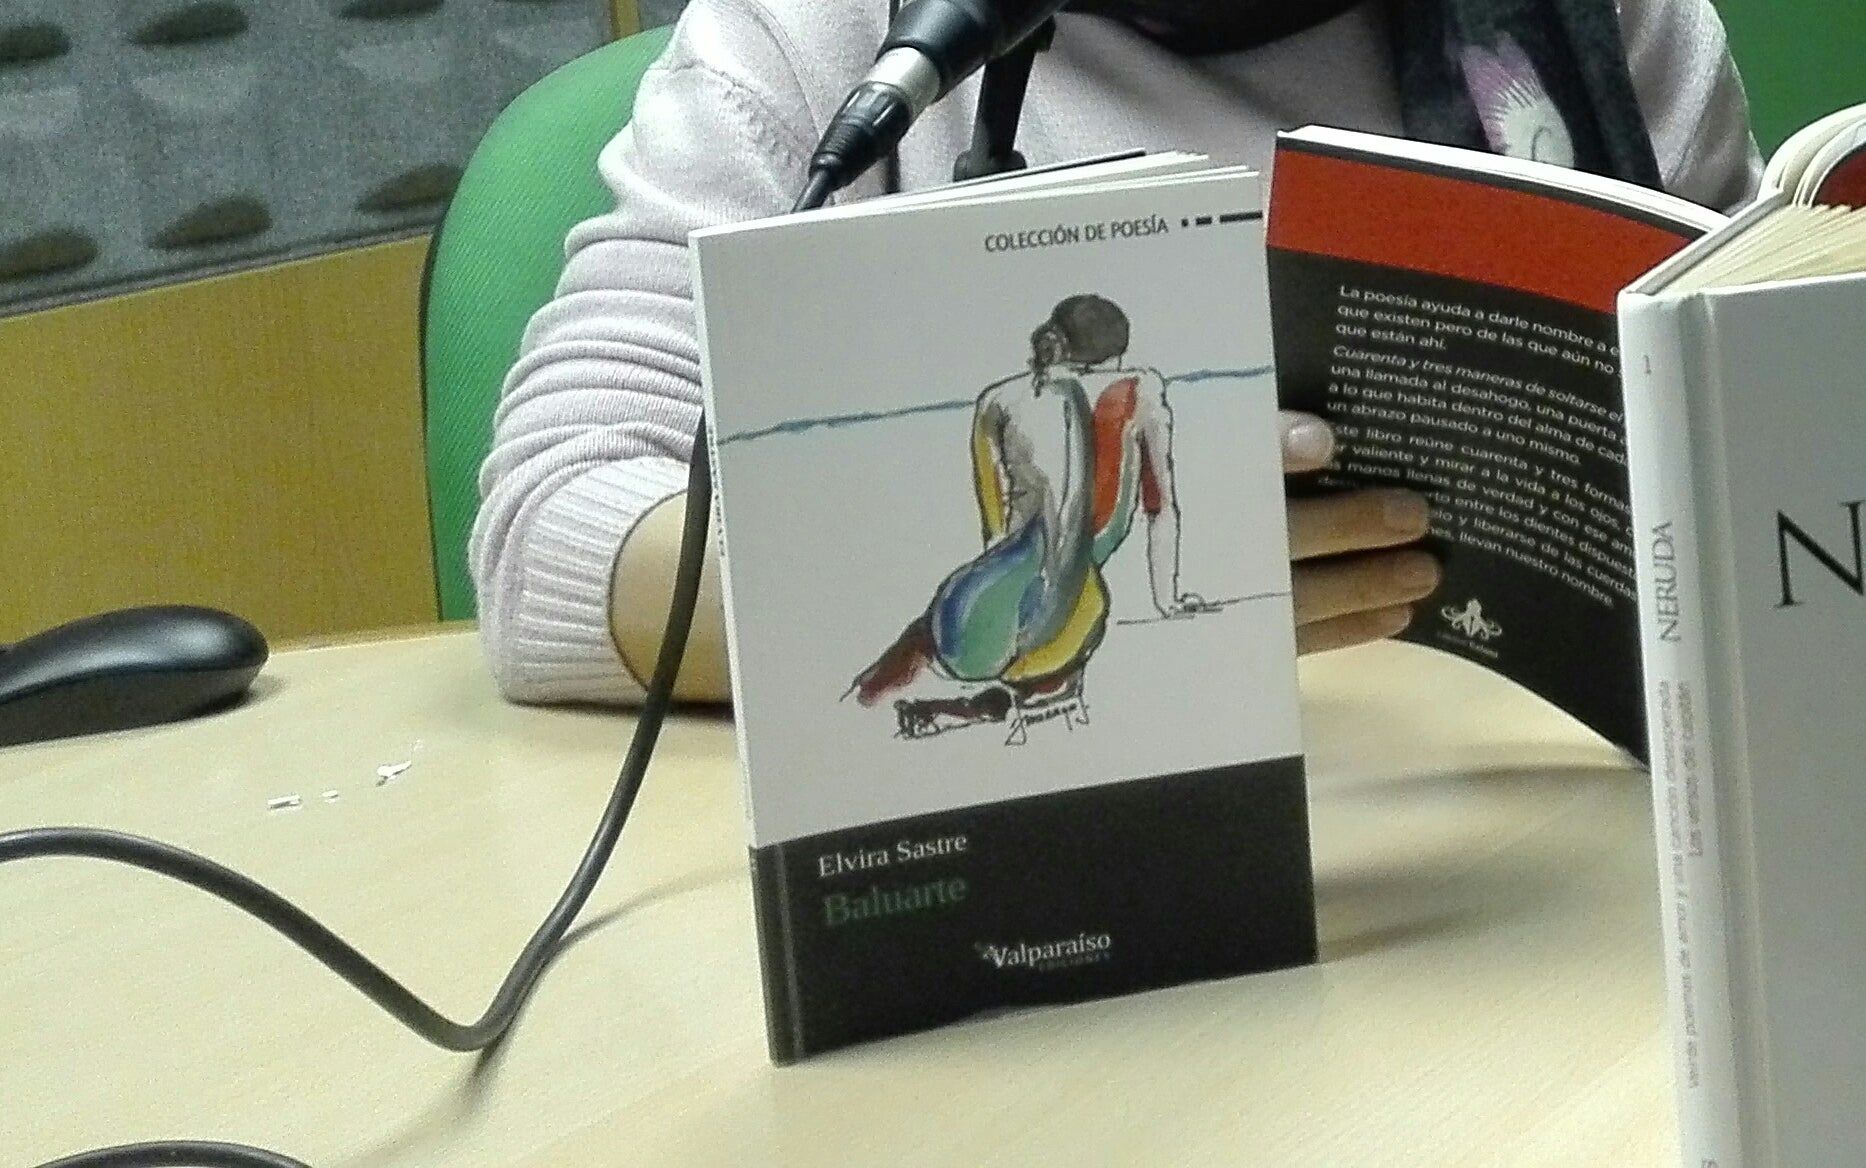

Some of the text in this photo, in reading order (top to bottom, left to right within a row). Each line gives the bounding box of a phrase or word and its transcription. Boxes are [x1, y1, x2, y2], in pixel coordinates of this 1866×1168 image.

[985, 214, 1169, 252] COLECCIÓN DE POESÍA
[1335, 324, 1367, 336] que
[1337, 305, 1369, 318] que
[1374, 312, 1430, 328] existen
[1435, 321, 1472, 336] pero
[1476, 328, 1498, 341] de
[1502, 332, 1523, 347] las
[1527, 340, 1558, 355] que
[1594, 359, 1615, 374] no
[1340, 285, 1360, 298] La
[1421, 301, 1471, 317] ayuda
[1474, 310, 1485, 320] a
[1488, 312, 1529, 329] darle
[1532, 322, 1594, 347] nombre
[1597, 342, 1606, 352] a
[1331, 365, 1617, 440] una llamada al desahogo, una puerta
[1333, 345, 1407, 366] Cuarenta
[1408, 360, 1420, 370] y
[1422, 360, 1453, 374] tres
[1455, 367, 1522, 389] maneras
[1525, 382, 1546, 395] de
[1548, 388, 1607, 415] soltarse
[1327, 401, 1348, 412] un
[1351, 405, 1407, 421] abrazo
[1410, 413, 1478, 433] pausado
[1482, 427, 1492, 437] a
[1496, 430, 1526, 446] uno
[1329, 383, 1339, 393] a
[1342, 383, 1358, 396] lo
[1362, 388, 1393, 400] que
[1397, 392, 1447, 409] habita
[1451, 402, 1504, 421] dentro
[1508, 414, 1532, 429] del
[1535, 423, 1572, 442] alma
[1575, 437, 1595, 451] de
[1352, 445, 1414, 462] valiente
[1420, 455, 1429, 466] y
[1435, 458, 1475, 473] mirar
[1481, 468, 1490, 478] a
[1496, 469, 1509, 483] la
[1515, 477, 1546, 494] vida
[1551, 490, 1560, 501] a
[1565, 494, 1585, 511] los
[1366, 426, 1402, 443] libro
[1461, 444, 1528, 470] cuarenta
[1535, 465, 1544, 476] y
[1551, 469, 1578, 489] tres
[1347, 463, 1401, 478] manos
[1406, 468, 1450, 485] llenas
[1456, 479, 1476, 491] de
[1482, 486, 1534, 509] verdad
[1539, 504, 1548, 515] y
[1553, 510, 1579, 528] con
[1584, 524, 1608, 542] ese
[1455, 498, 1495, 514] entre
[1499, 506, 1520, 523] los
[1523, 517, 1575, 545] dientes
[1459, 516, 1468, 527] y
[1474, 517, 1536, 547] liberarse
[1541, 543, 1559, 557] de
[1564, 552, 1582, 569] las
[1460, 531, 1502, 552] llevan
[1505, 547, 1558, 576] nuestro
[1651, 520, 1682, 644] NERUDA
[818, 832, 969, 879] Elvira Sastre
[822, 874, 969, 928] Baluarte
[993, 933, 1111, 969] Valparaíso
